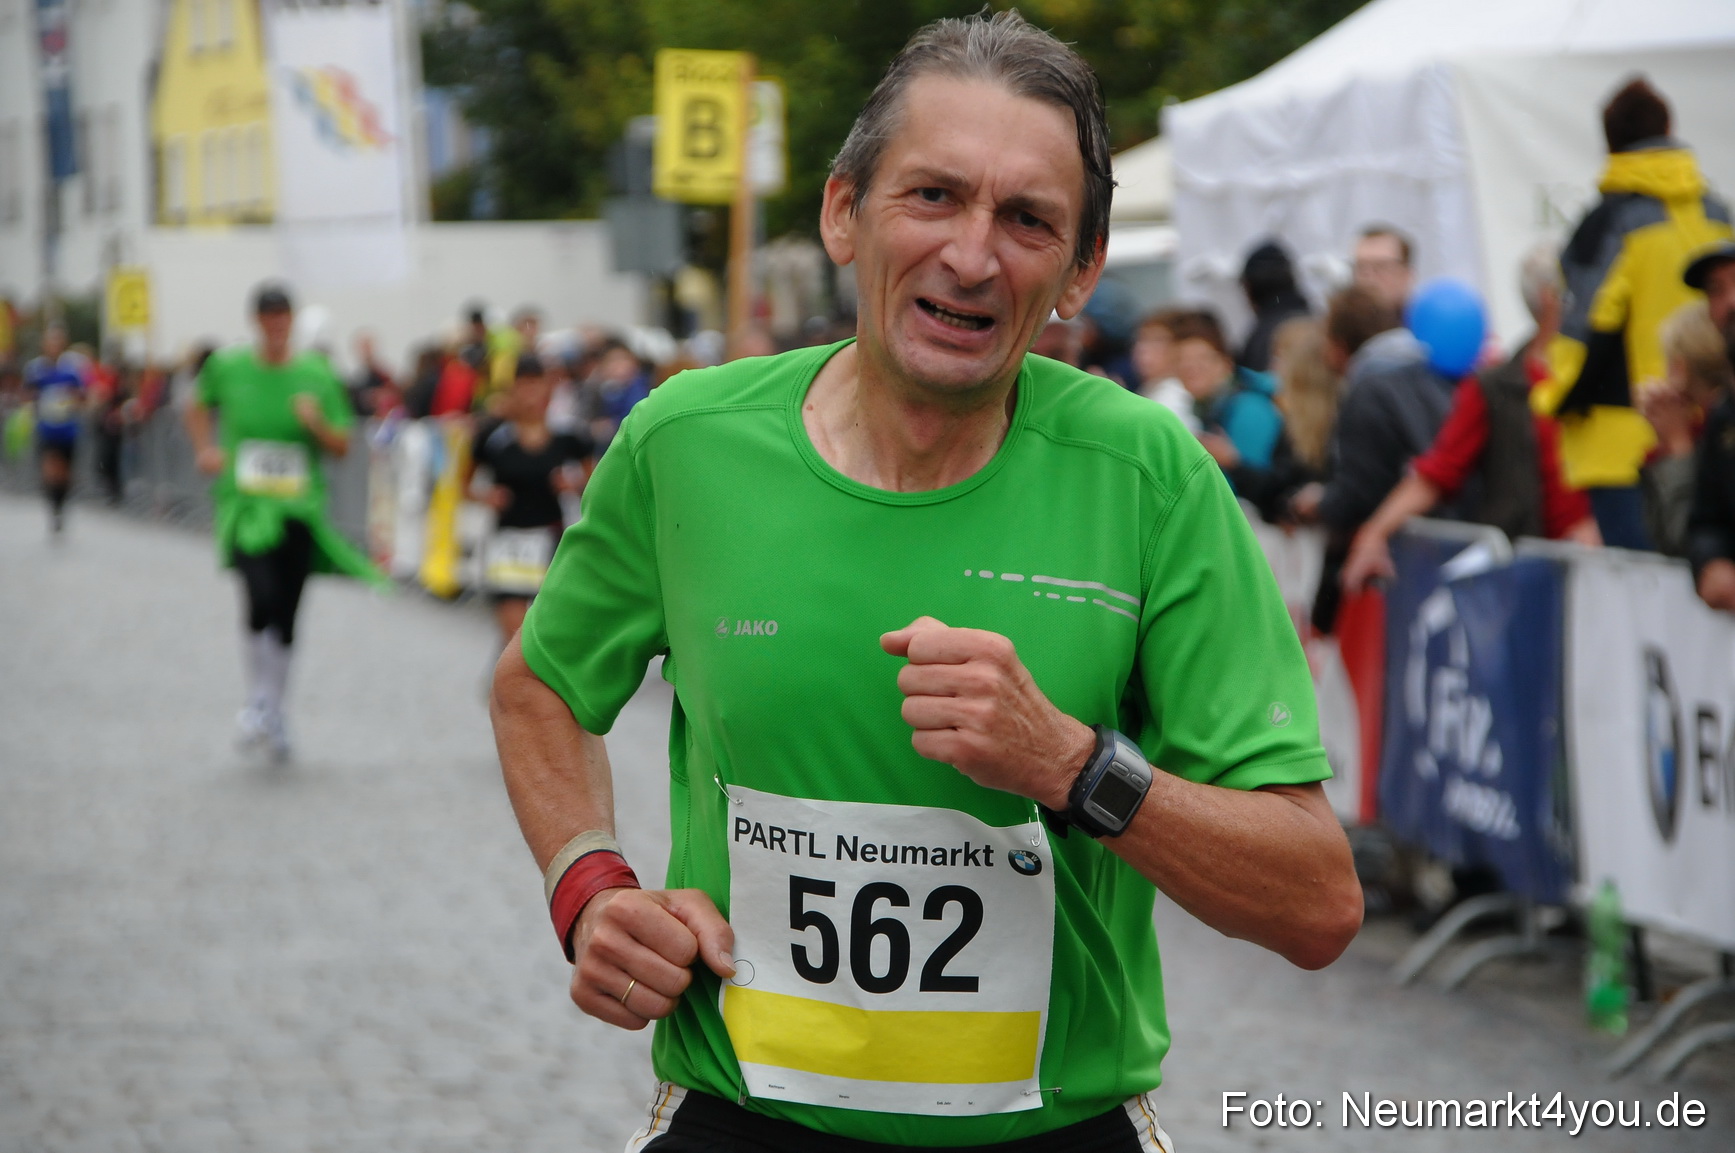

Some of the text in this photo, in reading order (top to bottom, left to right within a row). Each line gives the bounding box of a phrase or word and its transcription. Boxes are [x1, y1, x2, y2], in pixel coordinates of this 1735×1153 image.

[682, 95, 725, 160] B
[733, 619, 779, 636] JAKO
[734, 816, 994, 867] PARTL Neumarkt
[789, 874, 984, 995] 562
